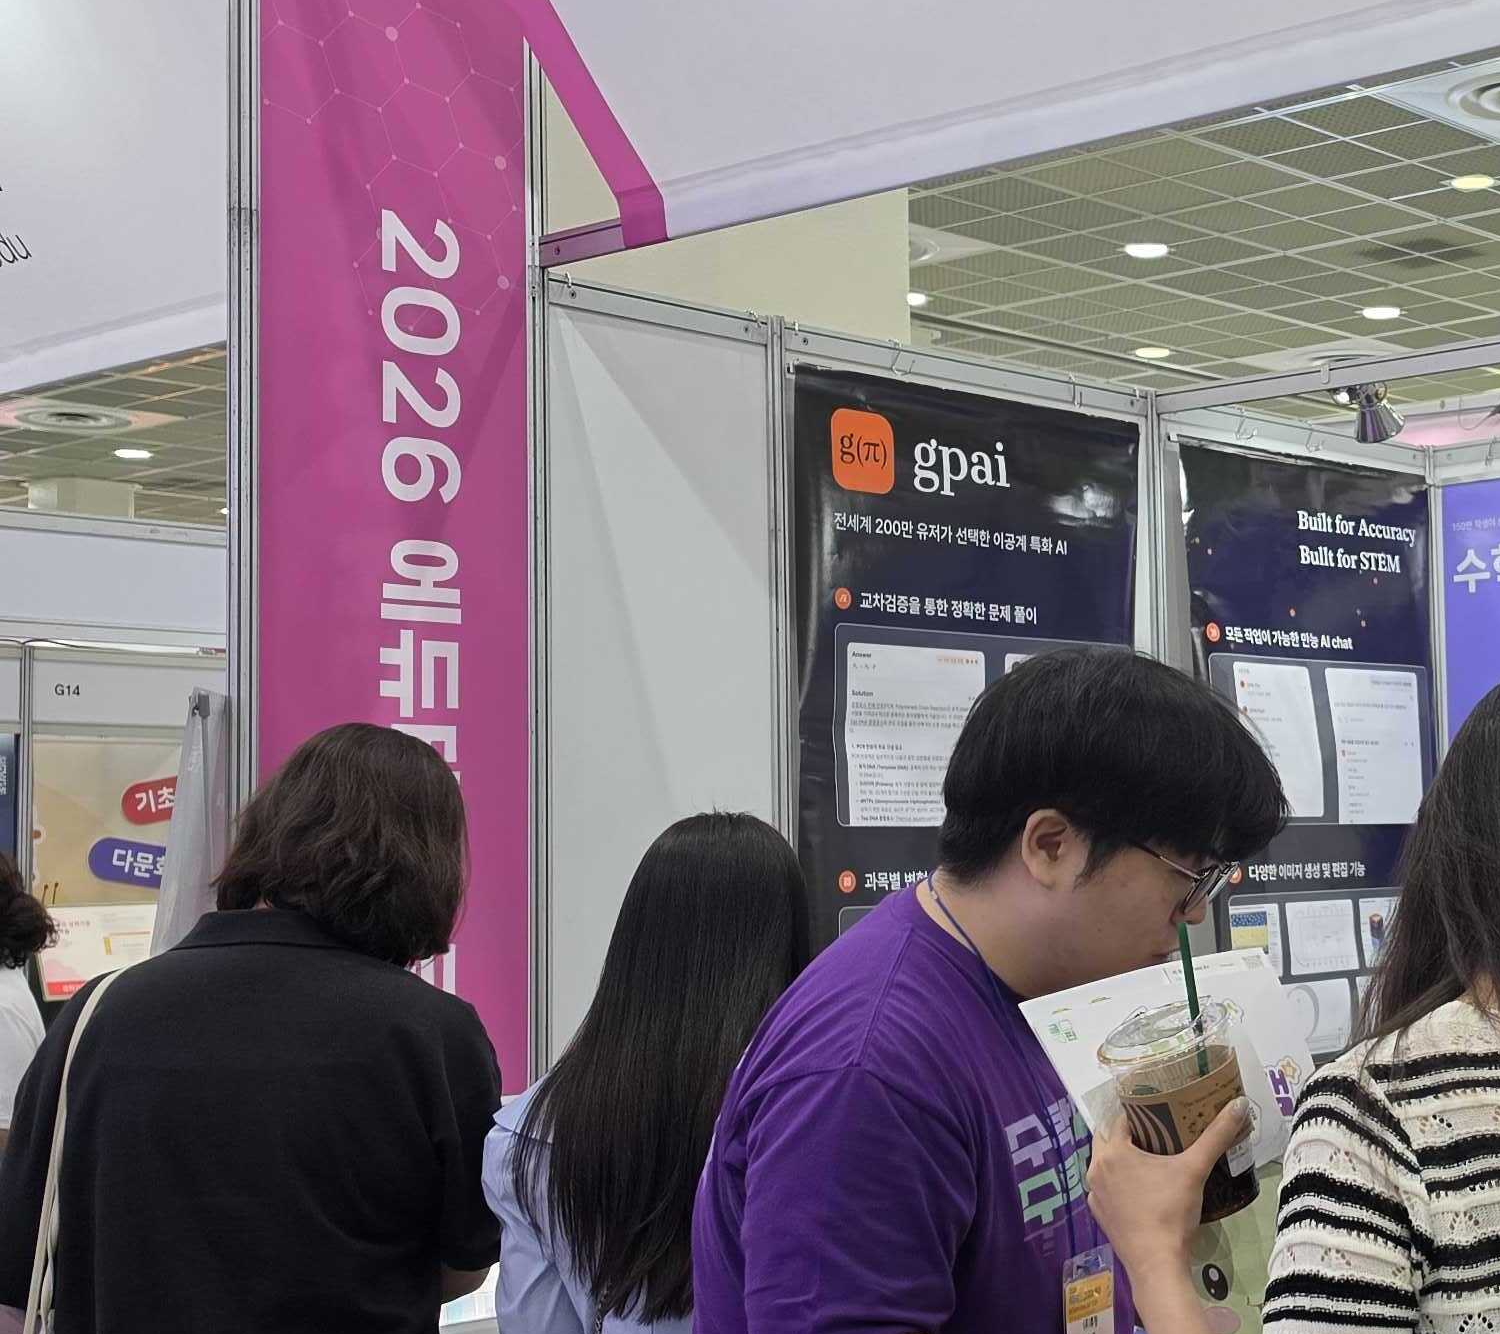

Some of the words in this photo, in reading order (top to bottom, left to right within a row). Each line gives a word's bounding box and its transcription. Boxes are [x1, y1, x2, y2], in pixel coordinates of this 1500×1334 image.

[379, 208, 462, 503] 2026
[913, 438, 1011, 497] gpai
[834, 511, 872, 534] 전세계
[875, 518, 914, 540] 200만
[916, 523, 953, 544] 유저가
[956, 528, 991, 549] 선택한
[994, 532, 1027, 554] 이공계
[1030, 535, 1053, 556] 특화
[1055, 539, 1068, 556] AI
[1297, 511, 1333, 533] Built
[1335, 515, 1356, 536] for
[1358, 518, 1416, 547] Accuracy
[1299, 545, 1335, 566] Built
[1337, 548, 1358, 569] for
[1359, 552, 1401, 573] STEM
[860, 592, 921, 616] 교차검증을
[924, 598, 949, 618] 통한
[951, 601, 986, 622] 정확한
[988, 604, 1011, 623] 문제
[1014, 606, 1038, 625] 풀이
[1320, 635, 1331, 649] AI
[1332, 635, 1353, 650] chat
[54, 683, 81, 697] G14
[864, 870, 901, 892] 과목별
[1248, 863, 1278, 882] 다양한
[1278, 863, 1303, 880] 이미지
